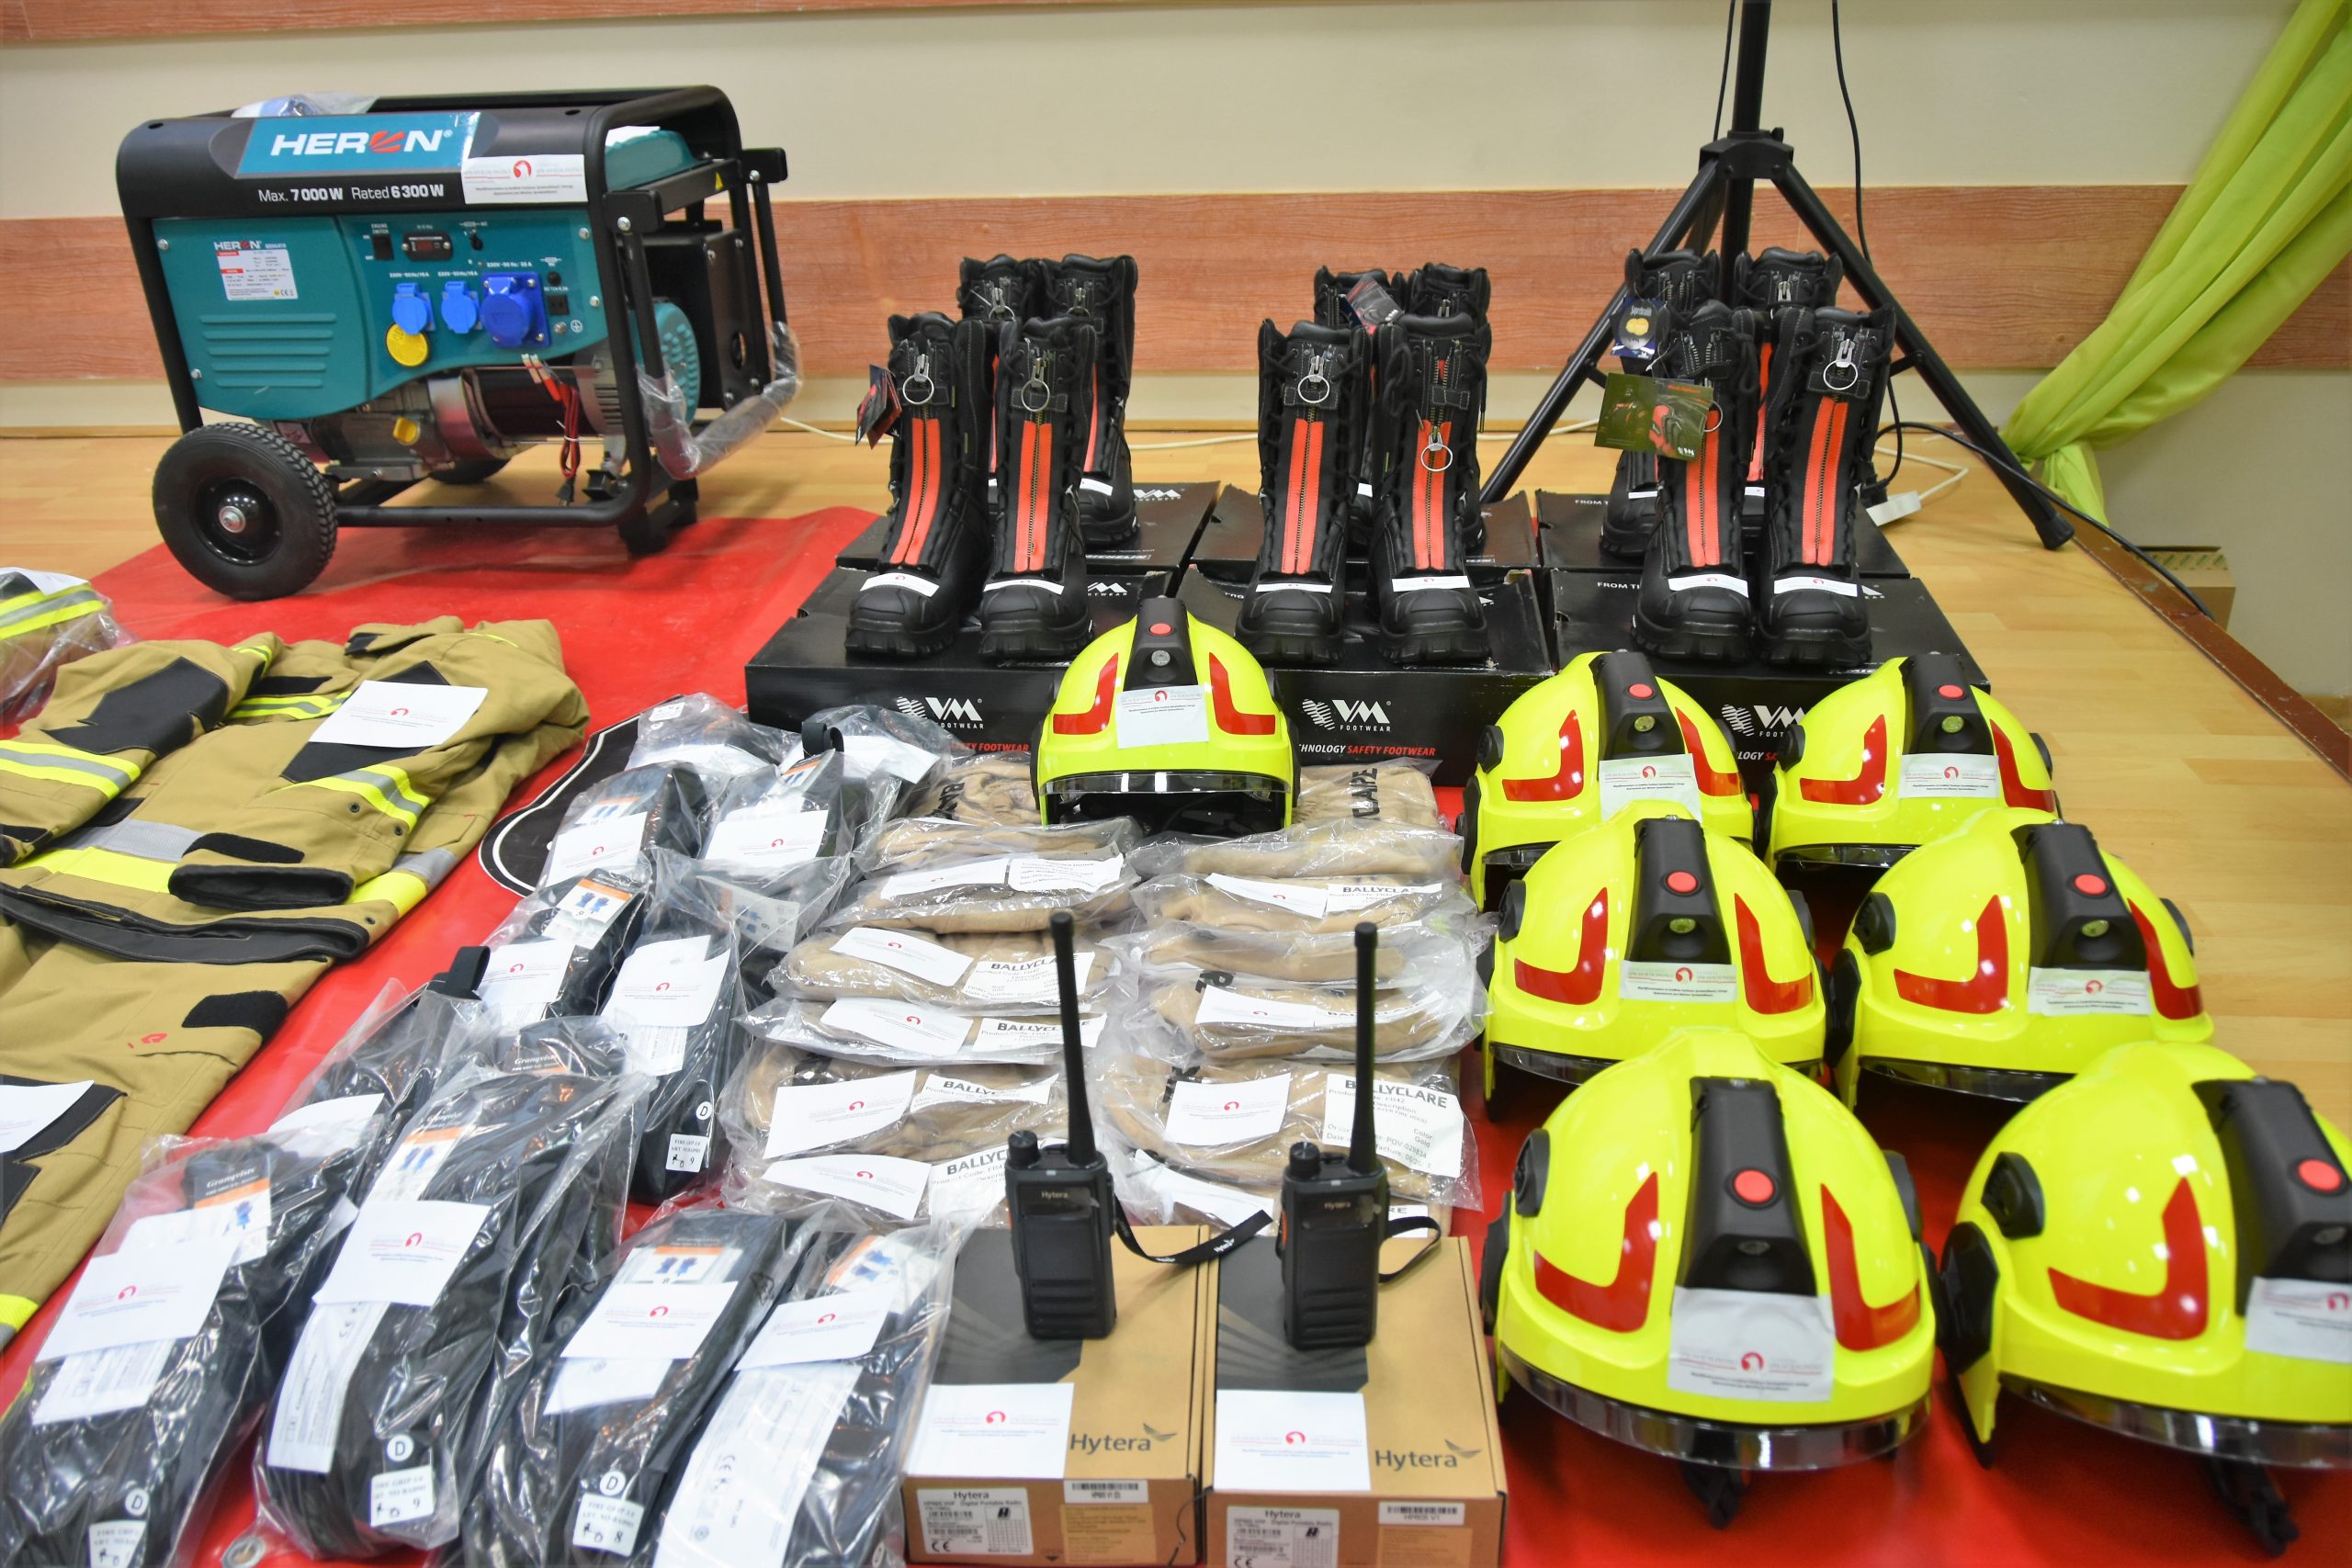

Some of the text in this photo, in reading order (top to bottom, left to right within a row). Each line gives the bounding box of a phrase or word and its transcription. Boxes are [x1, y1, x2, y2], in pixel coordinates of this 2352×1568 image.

[258, 189, 288, 202] Max.
[351, 186, 390, 200] Rated
[925, 696, 983, 722] VM
[1332, 700, 1391, 724] VM
[979, 742, 1030, 752] FOOTWEAR
[1299, 744, 1437, 756] HNOLOGY SAFETY FOOTWEAR
[1738, 751, 1765, 761] LOGY
[1345, 1079, 1448, 1109] BLYCLARE
[1415, 1136, 1430, 1148] Gold
[946, 1149, 1008, 1176] BALLYC
[395, 1440, 405, 1456] D
[1070, 1434, 1150, 1455] Hytera
[1375, 1450, 1457, 1472] Hytera
[606, 1475, 618, 1491] D
[132, 1495, 143, 1509] D
[954, 1491, 989, 1501] Hytera
[1265, 1509, 1301, 1519] Hytera
[932, 1541, 951, 1552] CE
